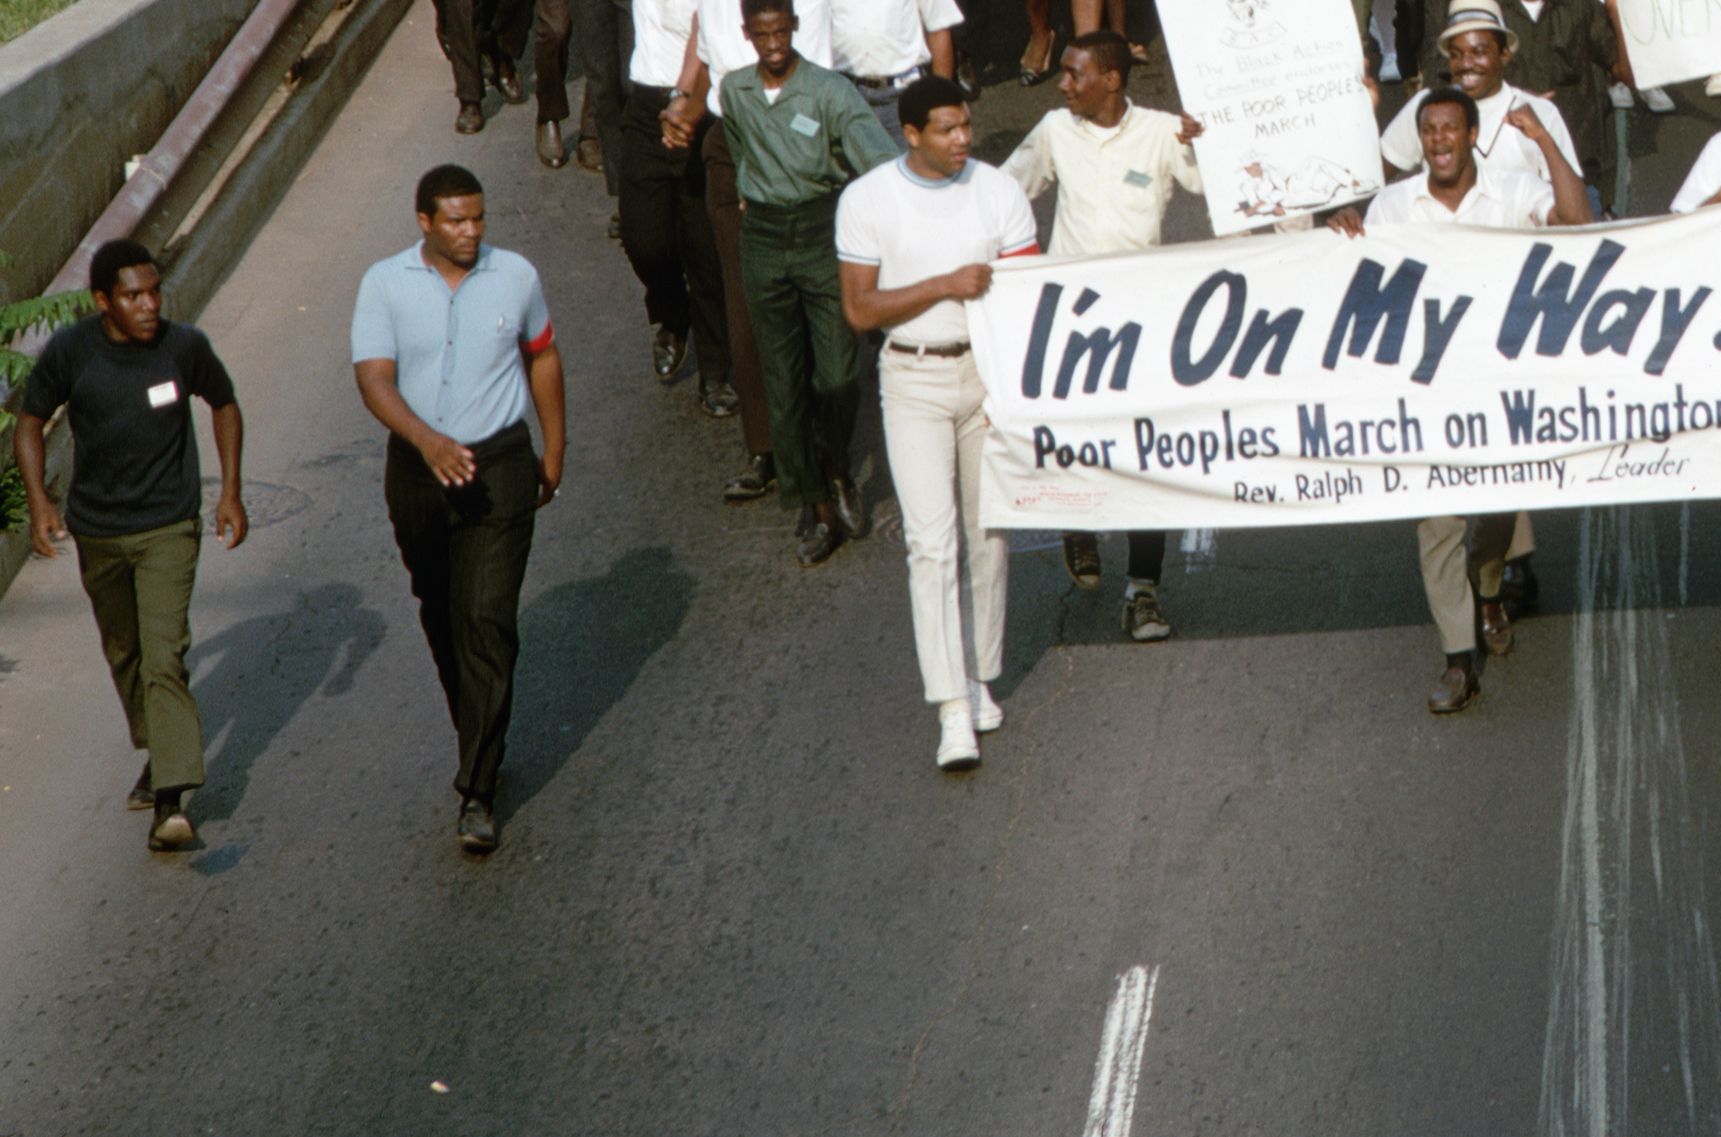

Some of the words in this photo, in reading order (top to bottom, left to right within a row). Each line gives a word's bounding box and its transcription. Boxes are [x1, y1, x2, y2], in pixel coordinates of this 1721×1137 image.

[1197, 105, 1235, 129] THE
[1241, 95, 1287, 119] POOR
[1254, 114, 1317, 139] MARCH
[1021, 282, 1143, 400] I'm
[1170, 268, 1304, 387] On
[1322, 257, 1474, 386] My
[1033, 424, 1116, 469] Poor
[1134, 409, 1280, 475] Peoples
[1297, 397, 1424, 460] March
[1445, 412, 1488, 449] on
[1234, 481, 1284, 504] Rev.
[1296, 469, 1363, 504] Ralph
[1383, 466, 1408, 494] D.
[1587, 443, 1692, 482] Leader
